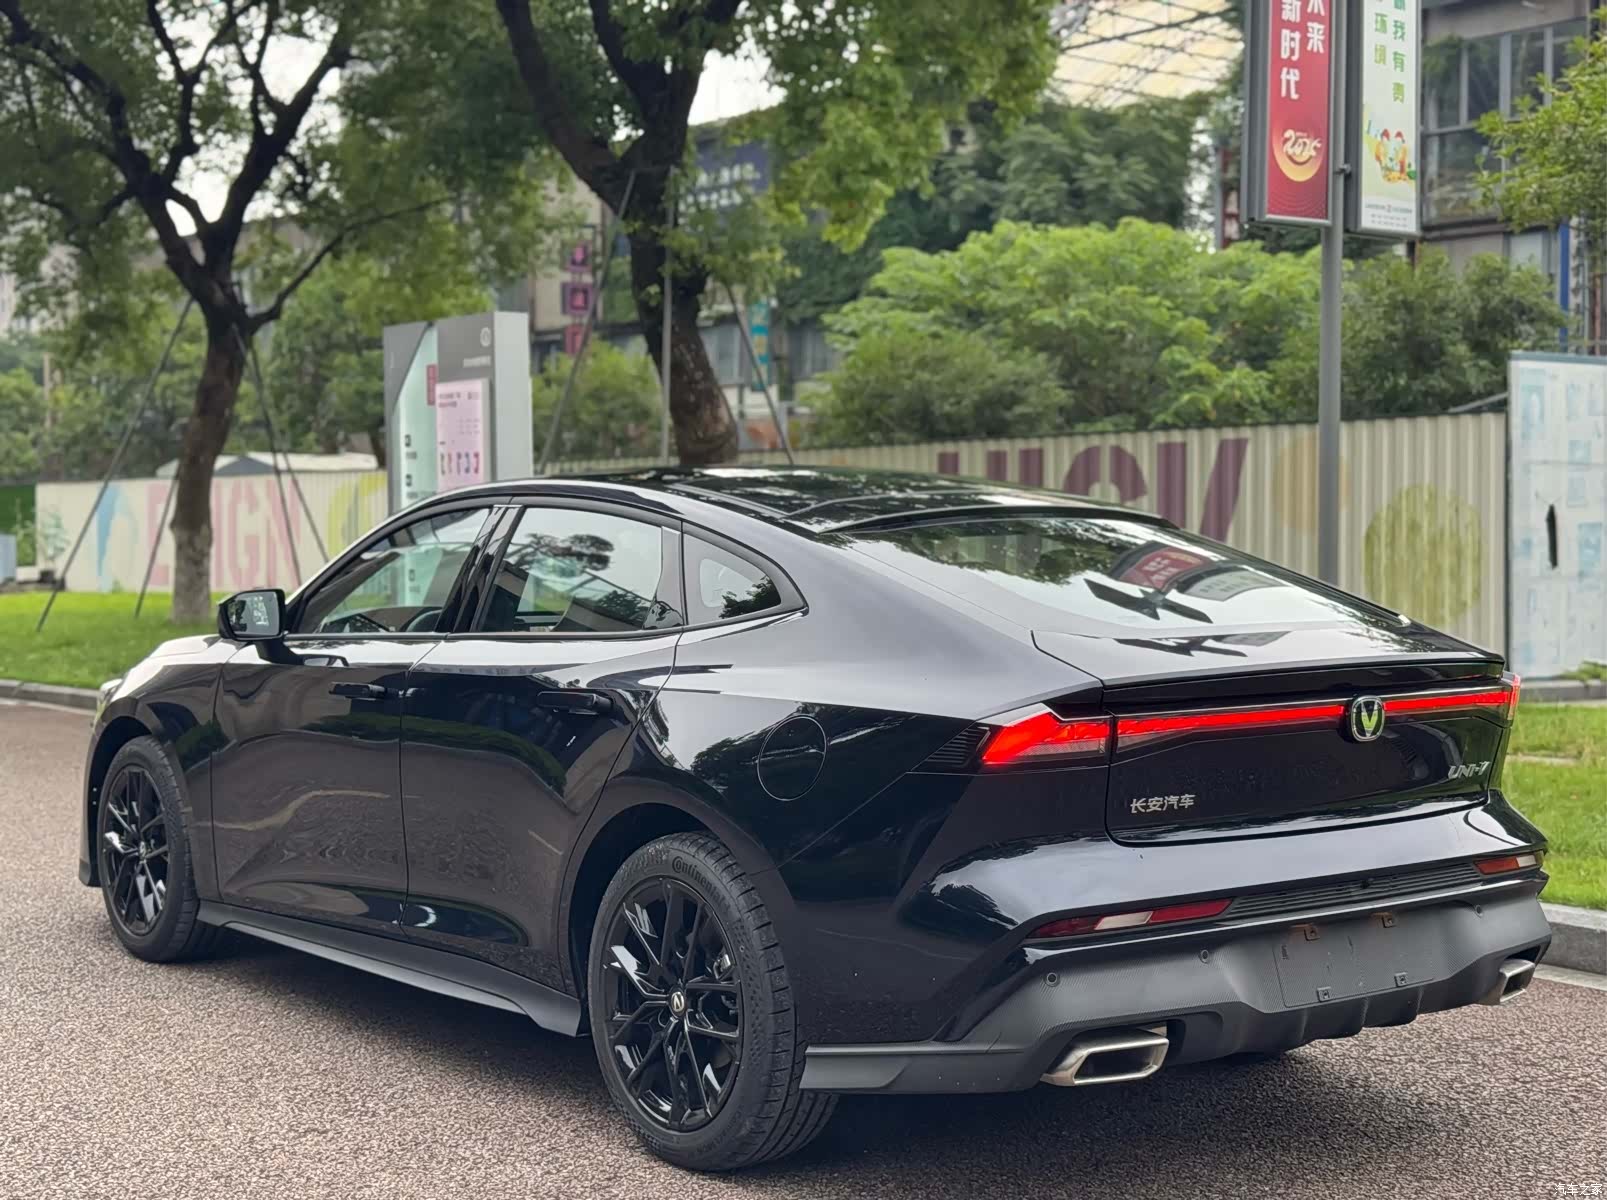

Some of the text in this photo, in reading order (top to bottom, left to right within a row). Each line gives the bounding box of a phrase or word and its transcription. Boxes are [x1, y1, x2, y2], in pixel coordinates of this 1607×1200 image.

[1280, 0, 1301, 100] 新时代
[1130, 794, 1196, 814] 长安汽车
